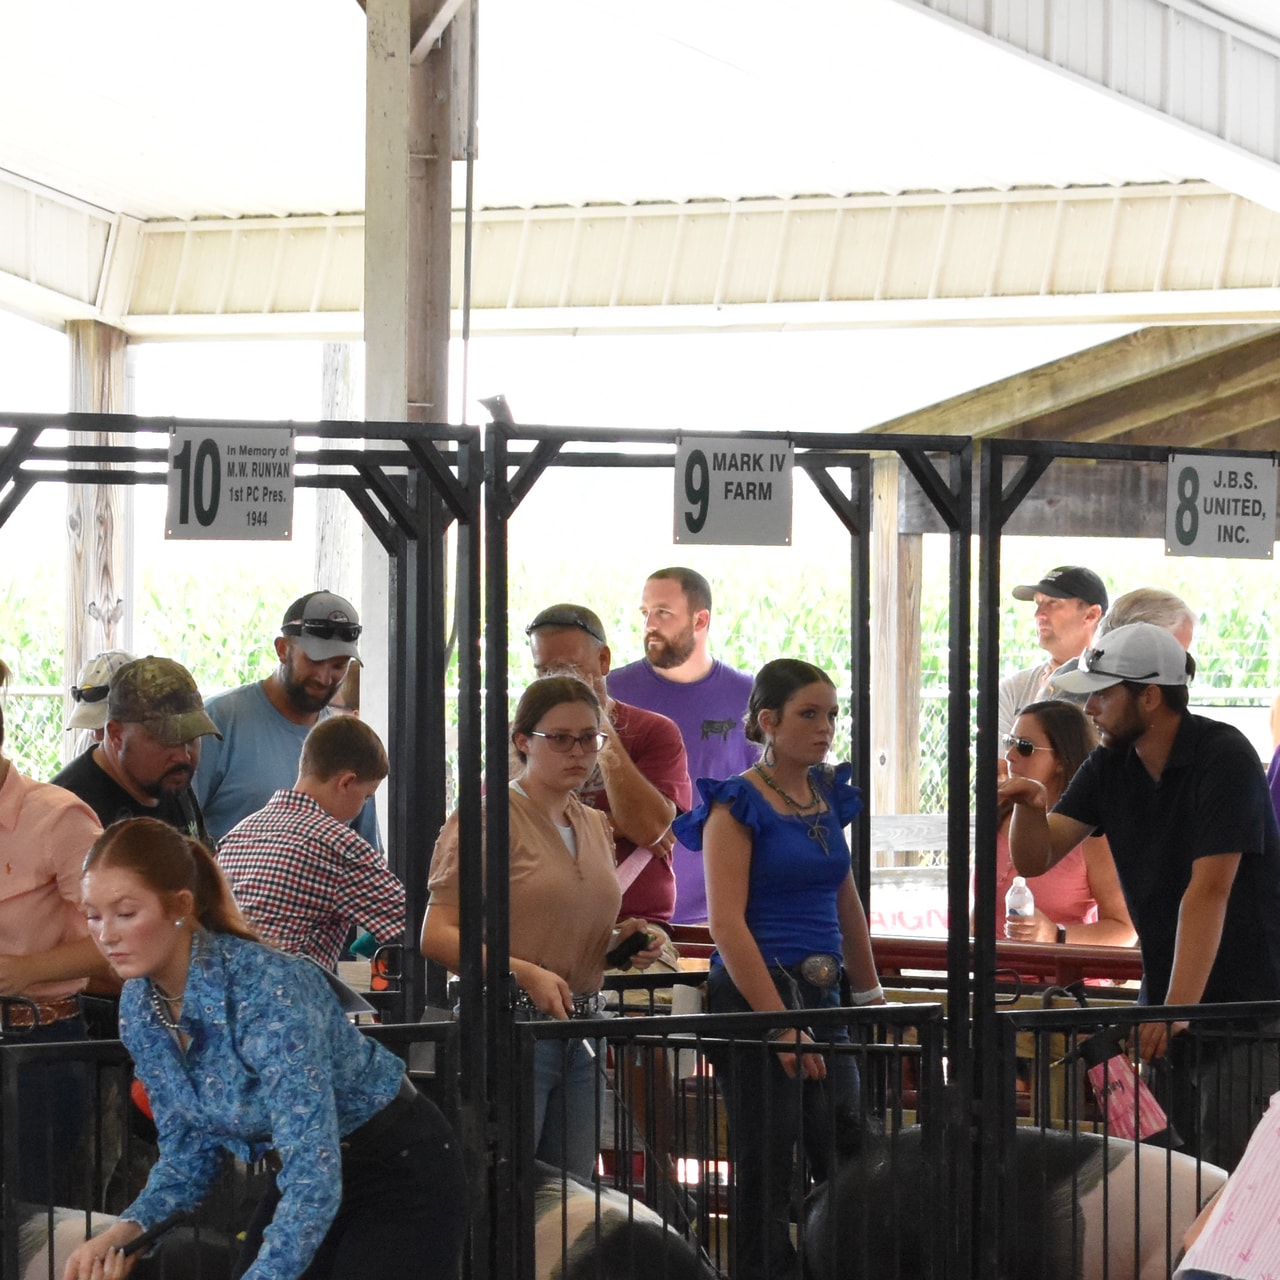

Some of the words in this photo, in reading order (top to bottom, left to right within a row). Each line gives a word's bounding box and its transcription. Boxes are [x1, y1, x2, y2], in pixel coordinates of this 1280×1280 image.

[227, 445, 236, 456] In
[240, 445, 277, 459] Memory
[279, 446, 289, 456] of
[712, 452, 764, 472] MARK
[769, 453, 786, 472] IV
[227, 461, 248, 478] M.W.
[251, 462, 290, 478] RUNYAN
[173, 438, 221, 527] 10
[1213, 470, 1258, 490] J.B.S.
[229, 486, 243, 502] 1st
[246, 486, 259, 502] PC
[262, 487, 287, 502] Pres.
[684, 449, 709, 534] 9
[724, 481, 772, 501] FARM
[1175, 466, 1200, 546] 8
[1203, 496, 1266, 521] UNITED,
[246, 511, 268, 526] 1944
[1217, 524, 1250, 544] INC.
